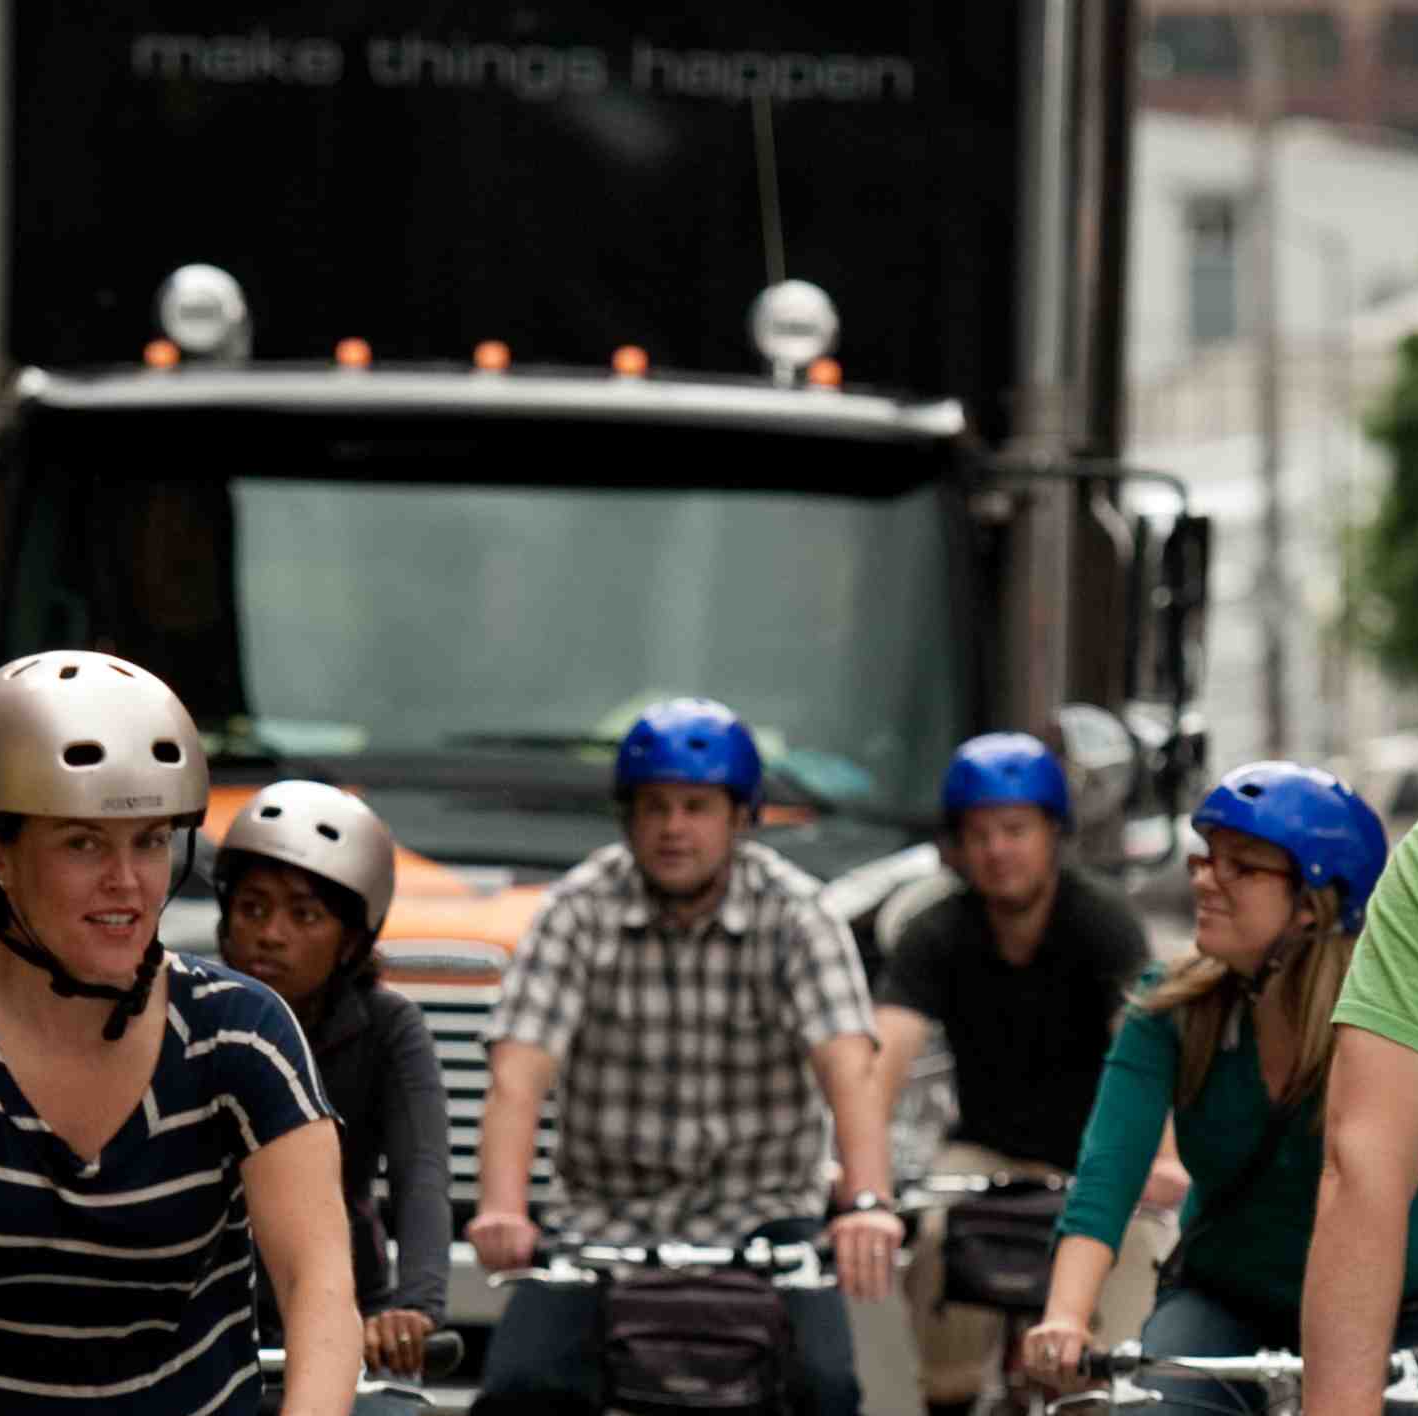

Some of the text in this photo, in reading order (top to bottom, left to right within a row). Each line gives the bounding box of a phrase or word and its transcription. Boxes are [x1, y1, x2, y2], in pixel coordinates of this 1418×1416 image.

[134, 27, 914, 101] make things happen
